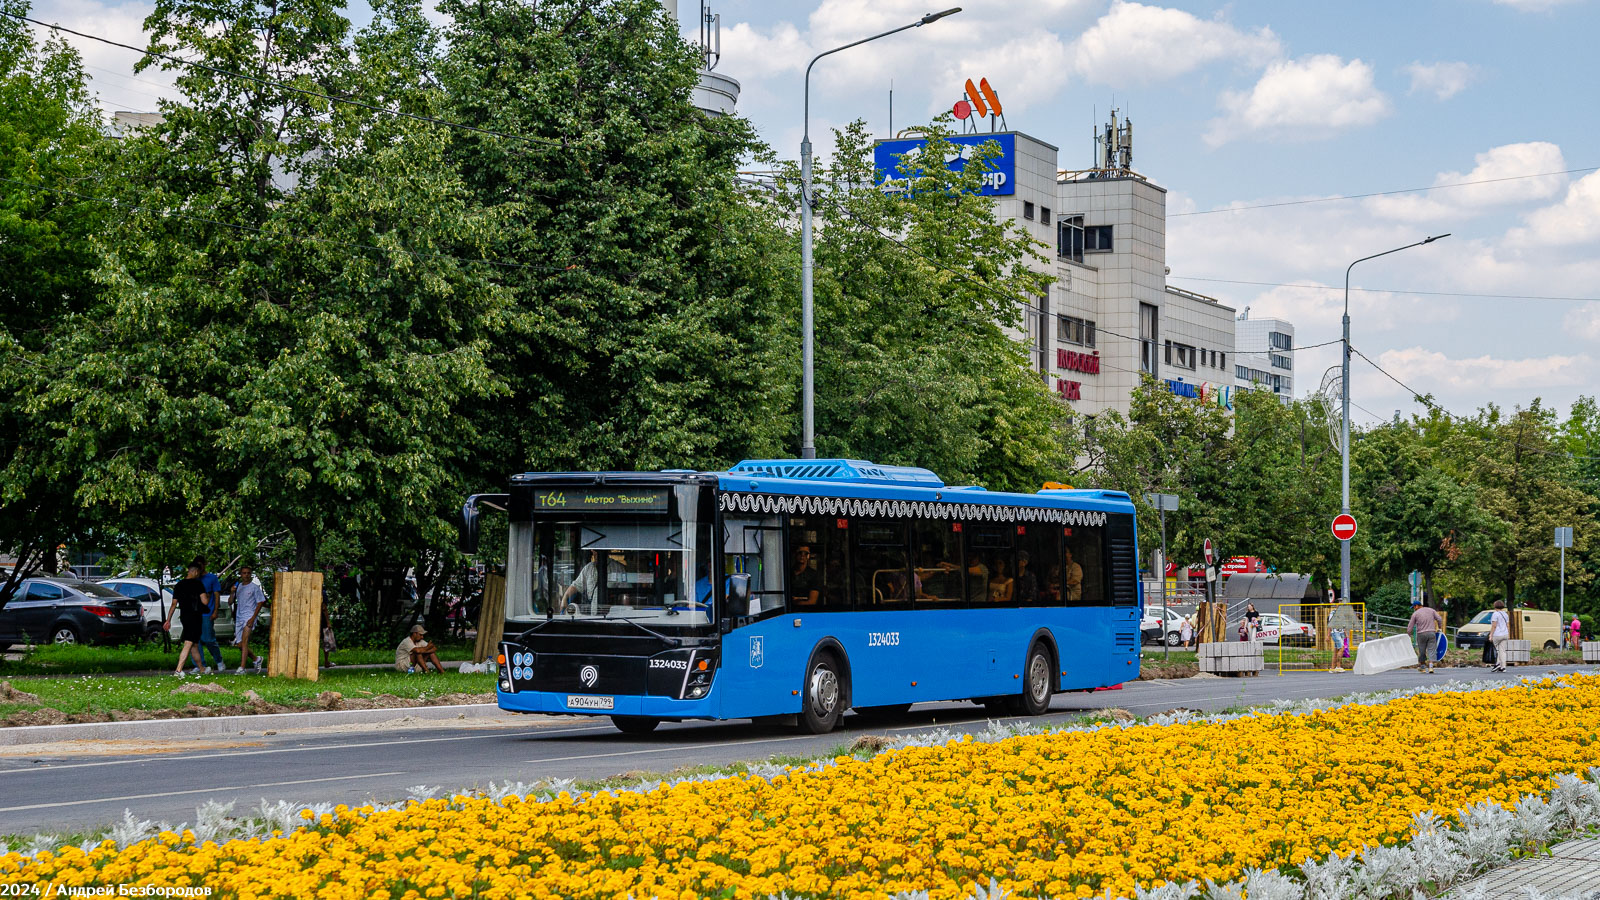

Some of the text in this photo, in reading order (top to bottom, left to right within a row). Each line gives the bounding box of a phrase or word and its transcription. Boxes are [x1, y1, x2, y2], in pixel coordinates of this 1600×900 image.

[584, 495, 615, 505] Метро
[868, 632, 900, 646] 1324033
[649, 660, 688, 670] 1324033
[570, 698, 599, 707] А904УН
